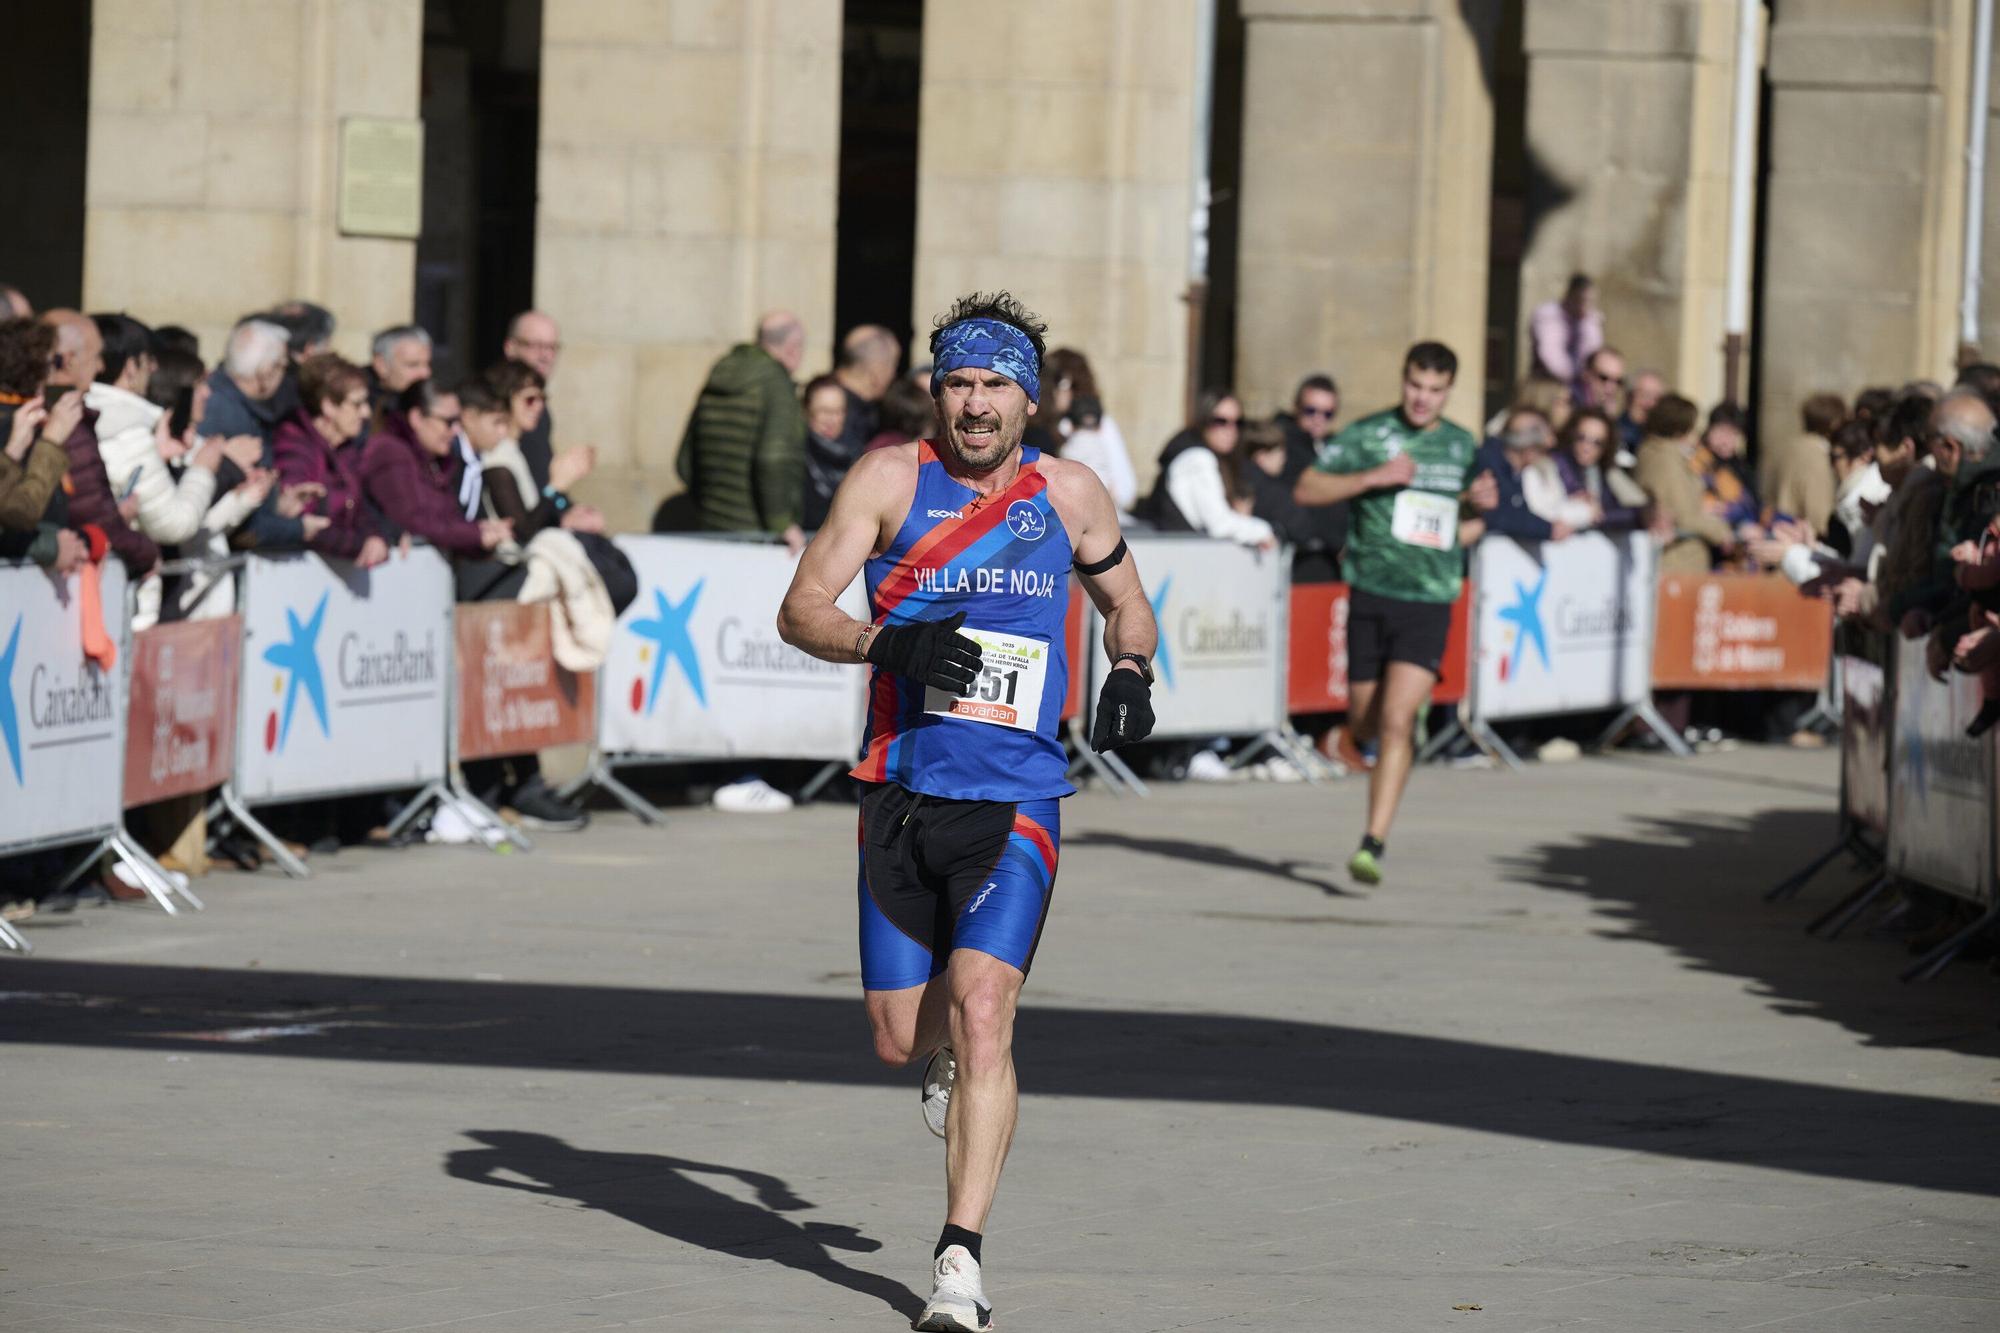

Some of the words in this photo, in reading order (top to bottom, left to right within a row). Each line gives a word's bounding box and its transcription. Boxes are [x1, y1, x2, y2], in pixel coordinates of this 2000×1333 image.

[914, 568, 971, 593] VILLA
[976, 568, 1004, 593] DE
[1010, 569, 1054, 598] NOJA
[339, 629, 435, 690] CaixaBank
[953, 703, 1014, 721] navarban
